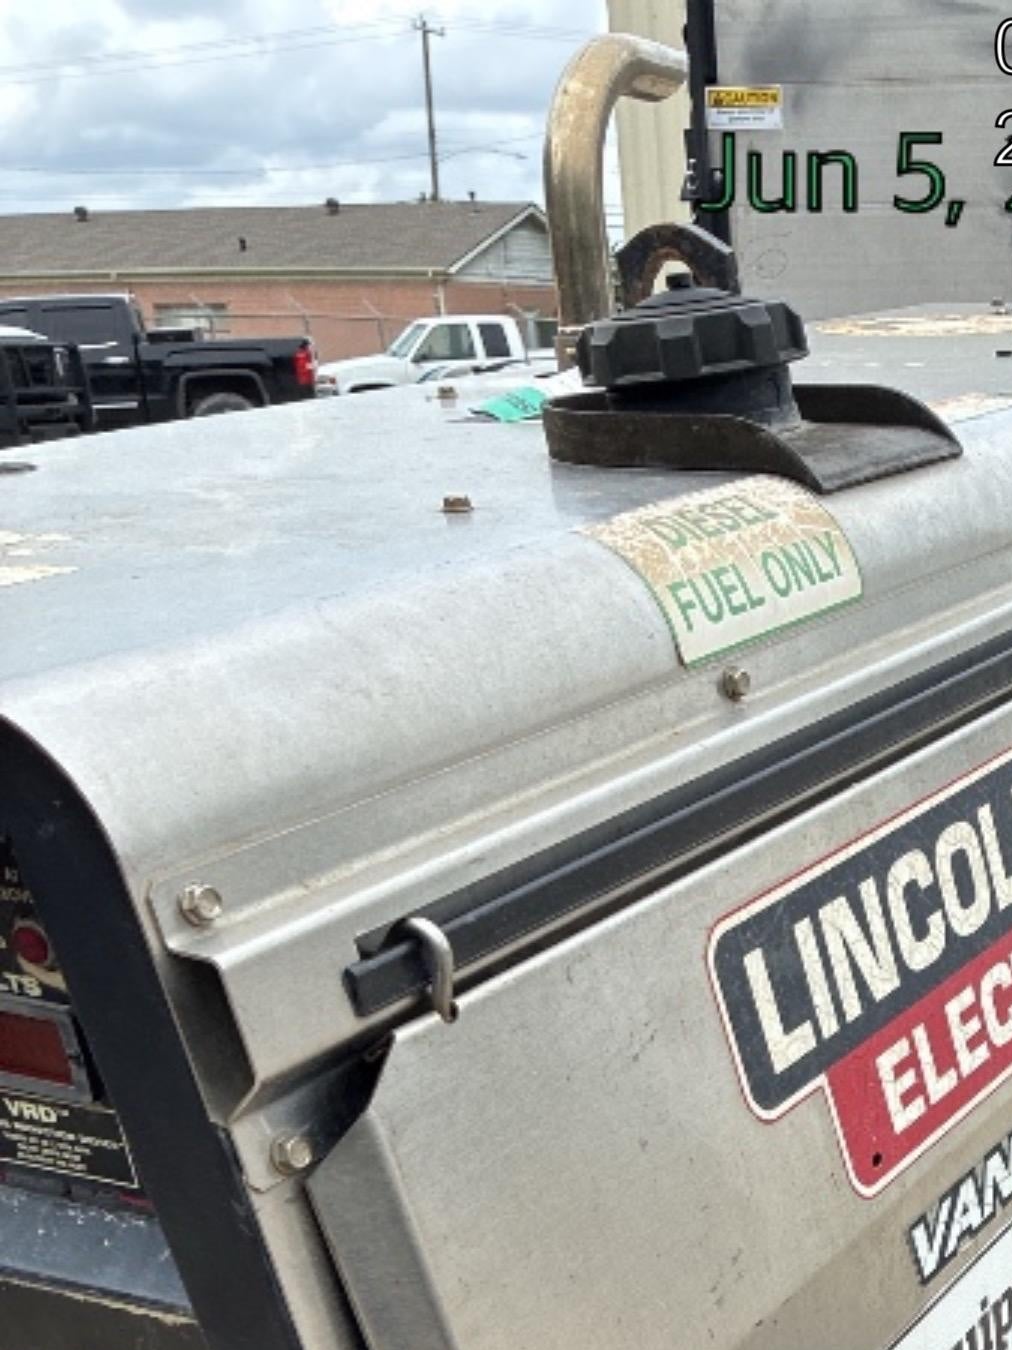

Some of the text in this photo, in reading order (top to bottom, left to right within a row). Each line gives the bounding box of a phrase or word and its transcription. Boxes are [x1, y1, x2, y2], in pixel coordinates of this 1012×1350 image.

[640, 496, 779, 549] DIESEL
[666, 530, 842, 632] FUEL ONLY
